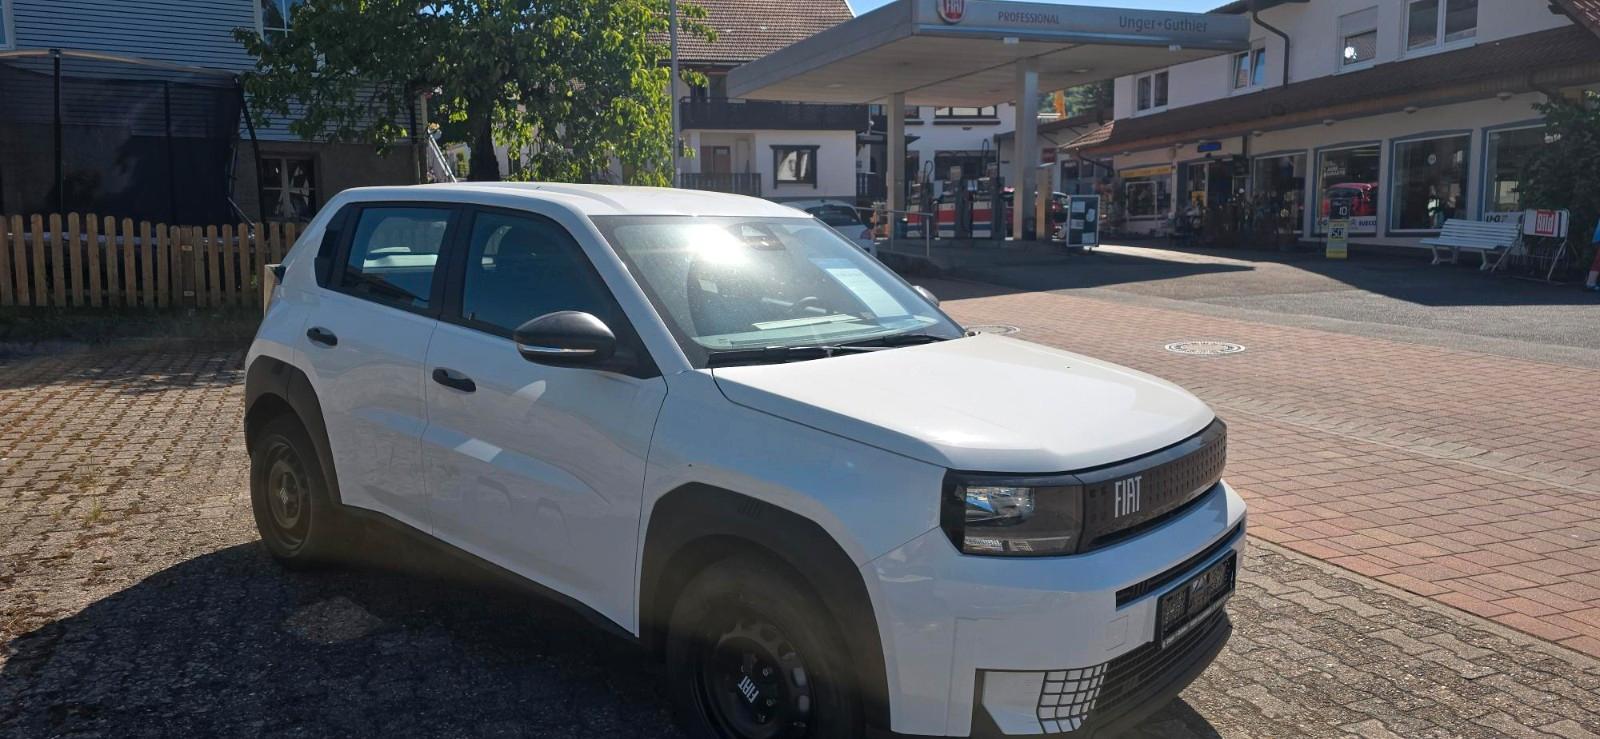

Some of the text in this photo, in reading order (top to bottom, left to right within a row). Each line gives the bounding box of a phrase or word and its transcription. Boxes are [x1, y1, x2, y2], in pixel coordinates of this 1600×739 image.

[998, 11, 1060, 24] PROFESSIONAL
[1114, 475, 1142, 518] FIAT
[737, 675, 760, 704] FIAT
